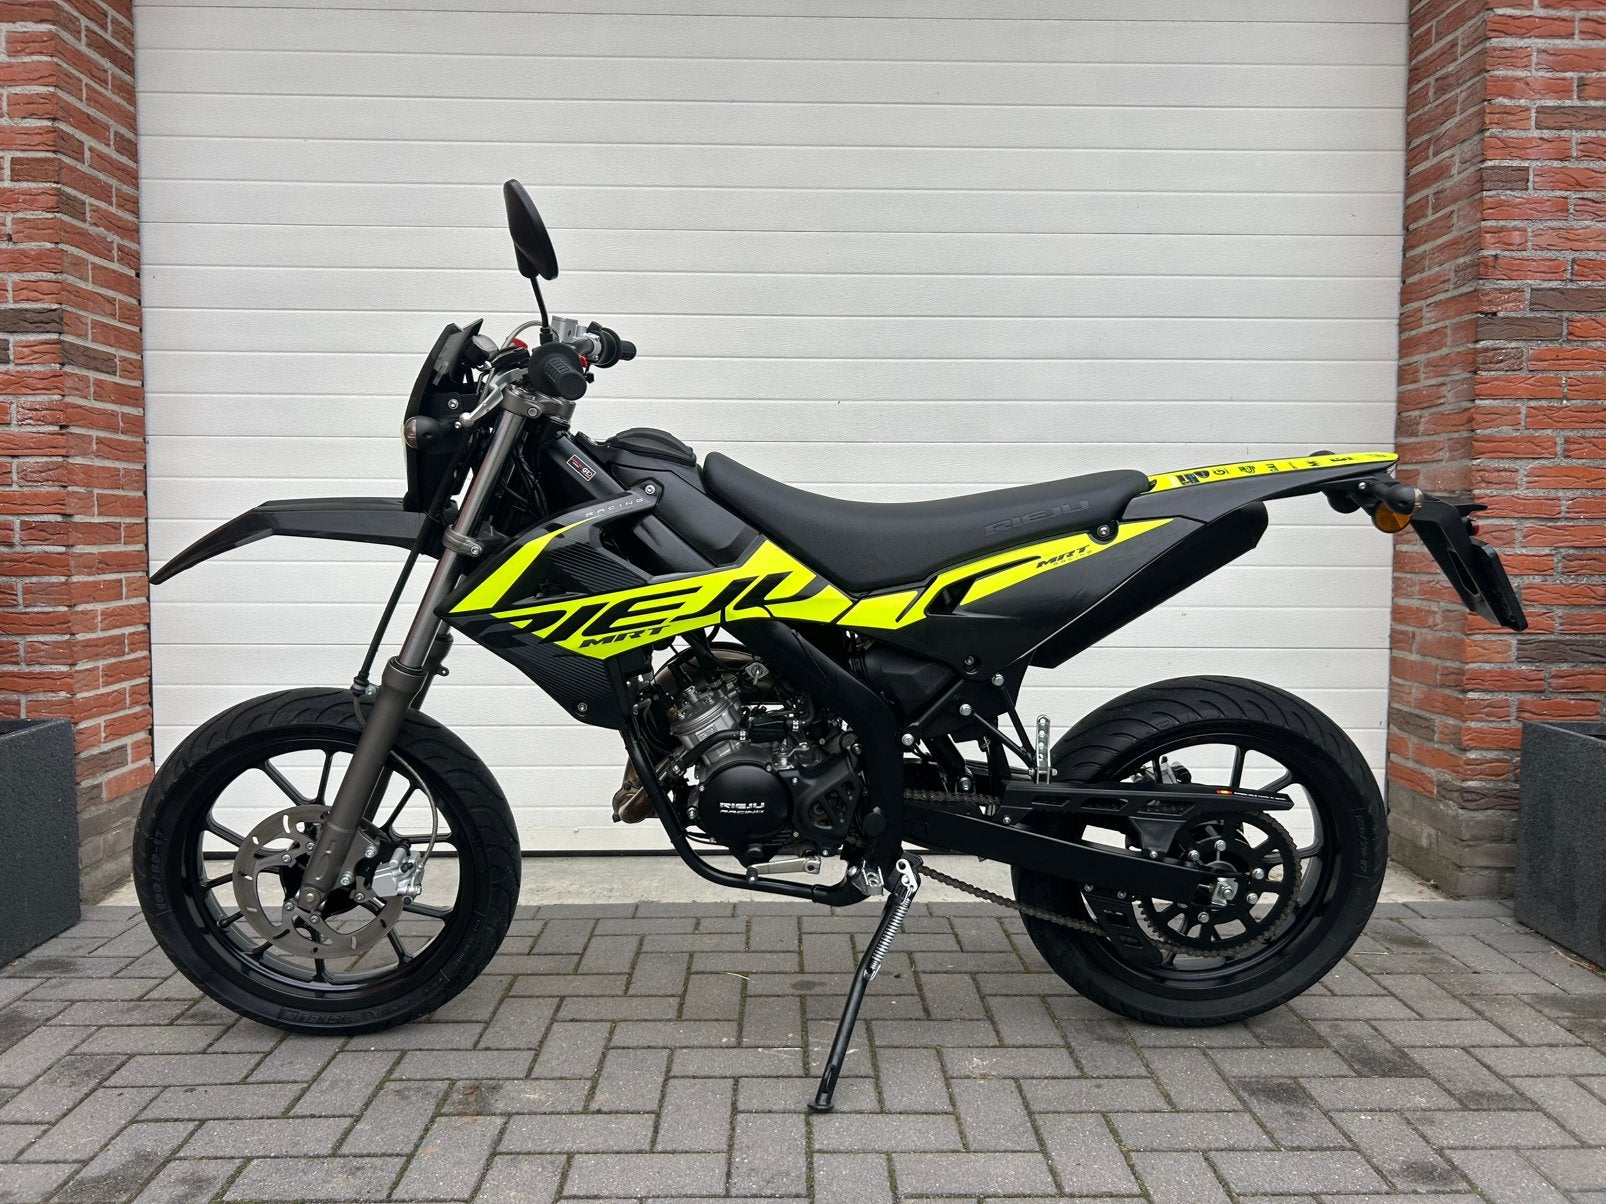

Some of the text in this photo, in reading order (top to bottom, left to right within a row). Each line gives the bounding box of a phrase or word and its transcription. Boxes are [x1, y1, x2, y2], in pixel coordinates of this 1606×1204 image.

[585, 497, 644, 518] RACING
[984, 498, 1090, 537] RIEJU
[1036, 544, 1090, 569] MRT
[578, 624, 671, 649] MRT
